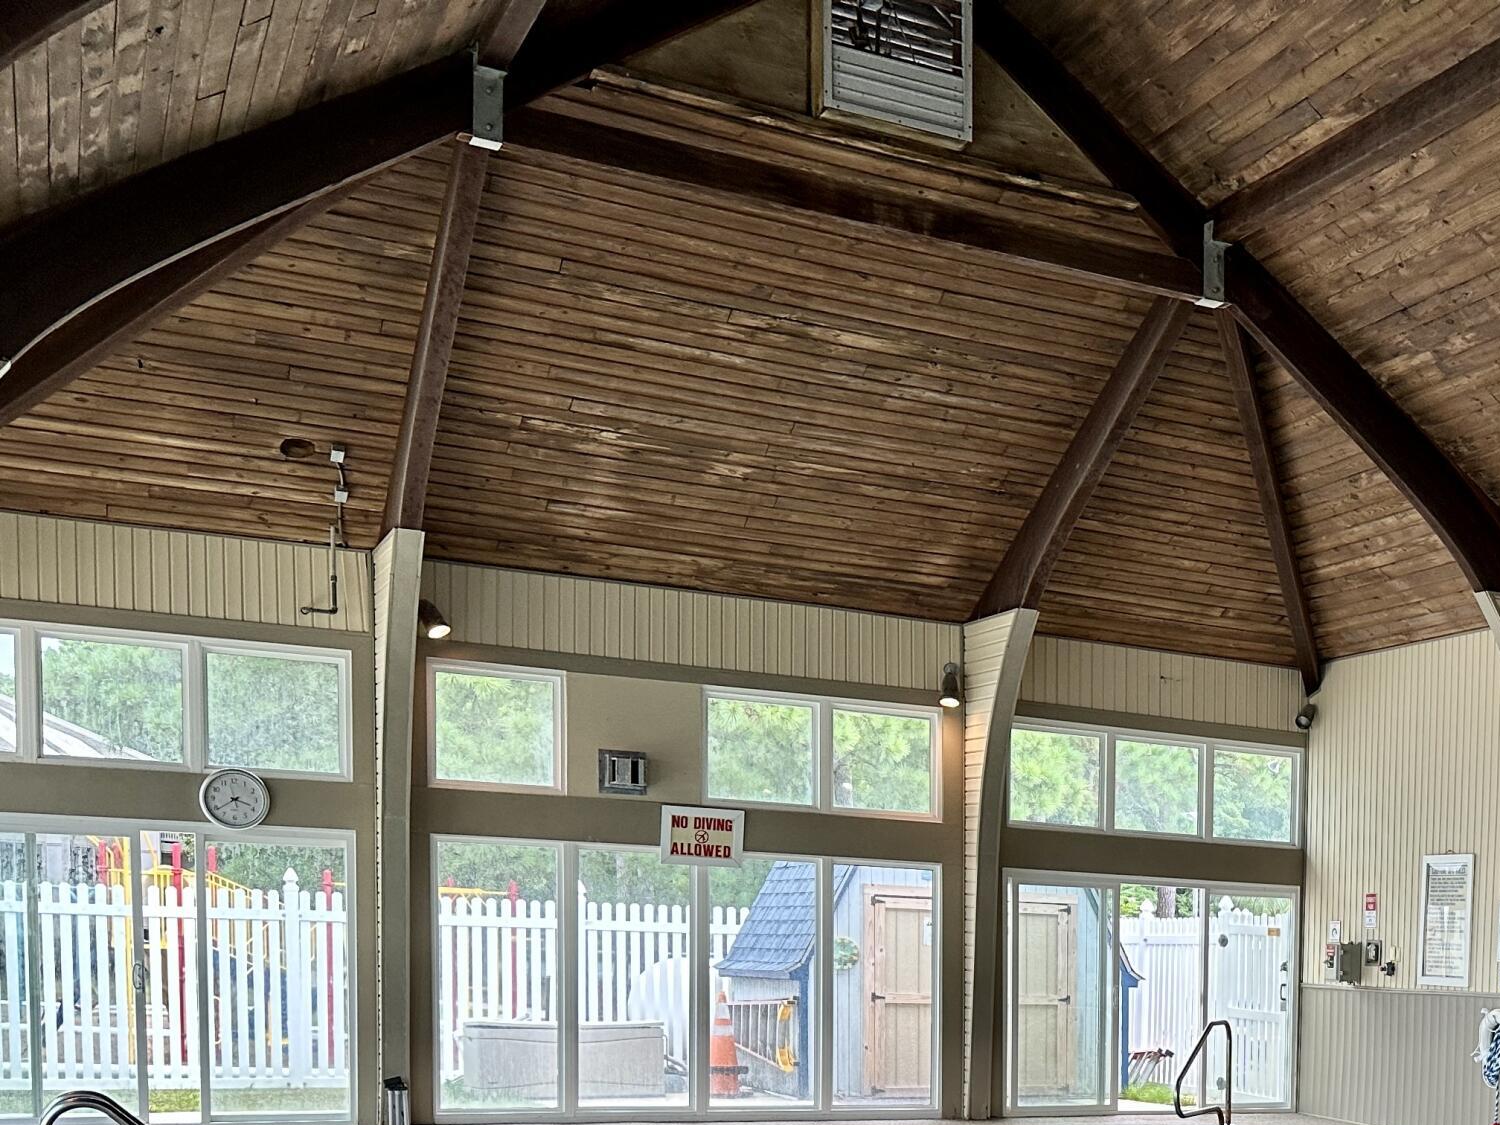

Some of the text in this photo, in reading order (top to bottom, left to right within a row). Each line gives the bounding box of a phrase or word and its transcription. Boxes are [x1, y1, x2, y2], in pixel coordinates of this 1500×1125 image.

[671, 815, 733, 832] NO DIVING
[670, 842, 731, 859] ALLOWED
